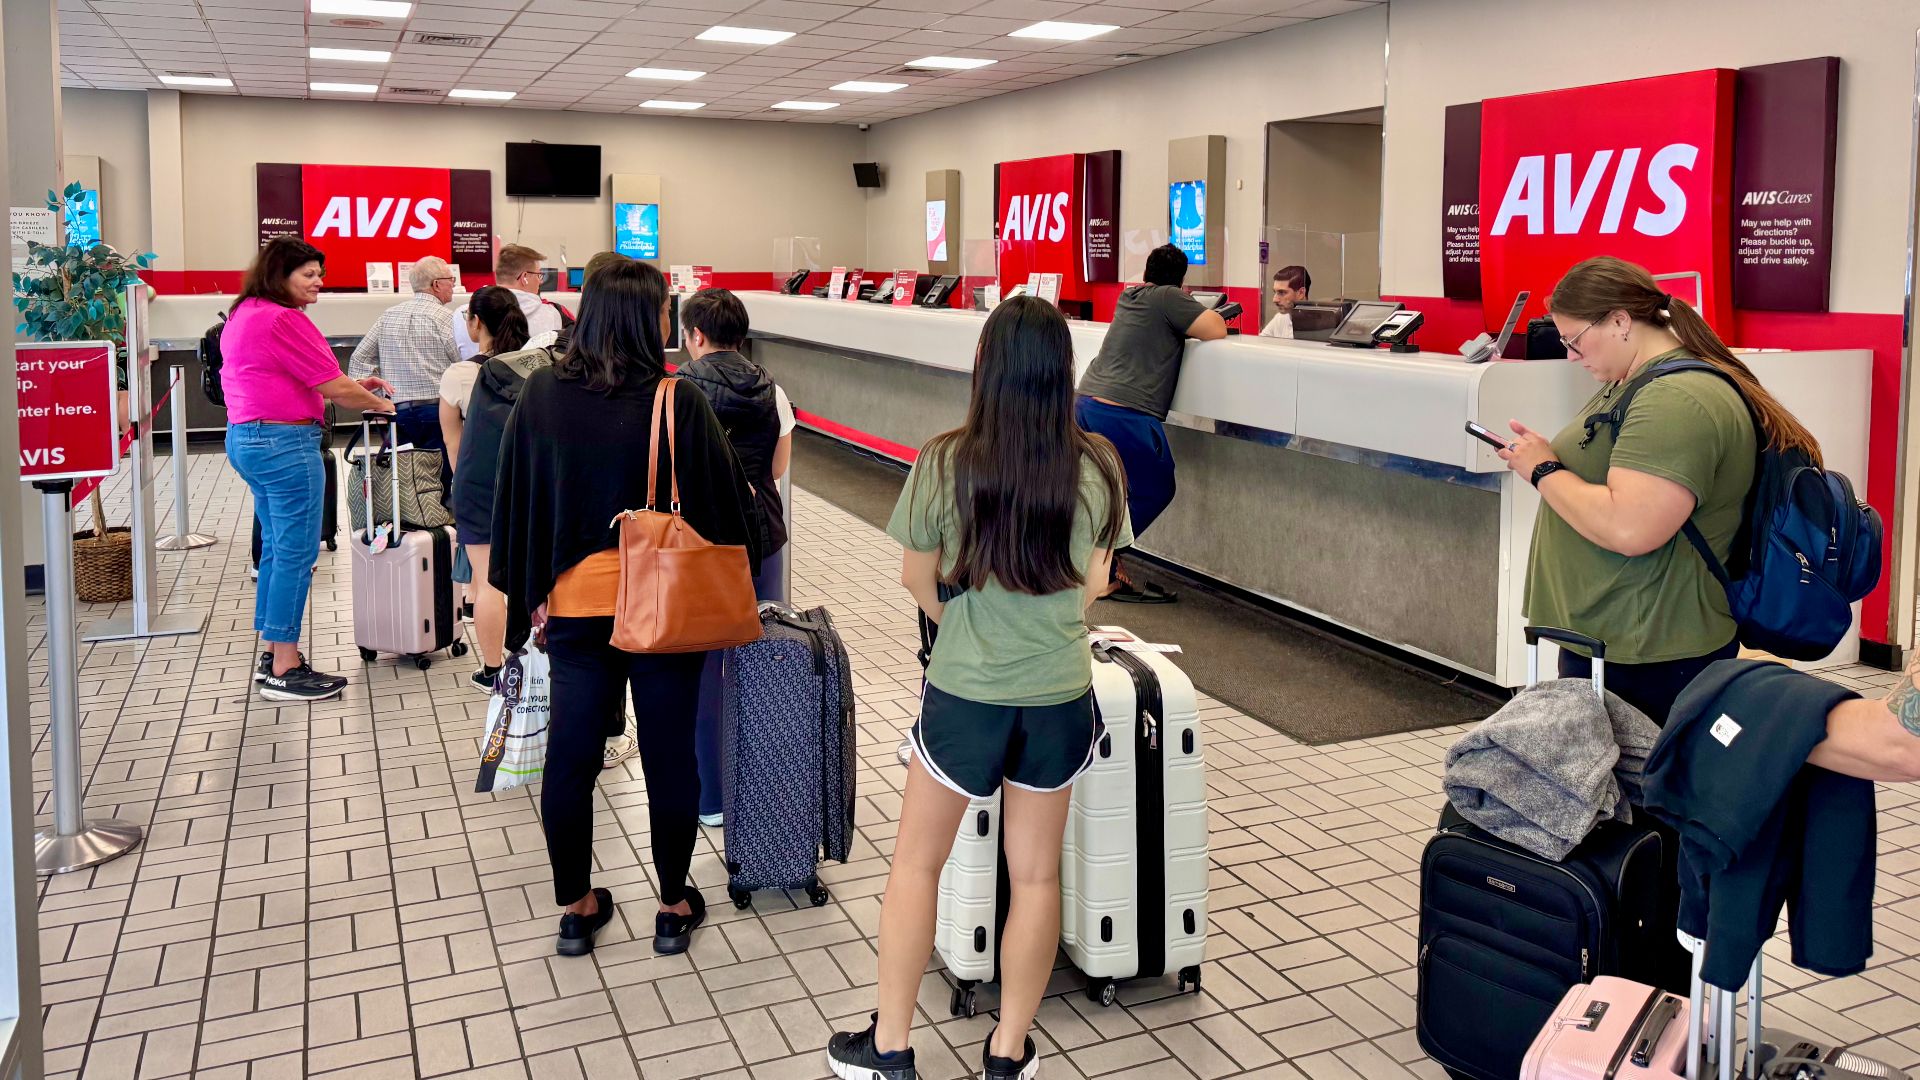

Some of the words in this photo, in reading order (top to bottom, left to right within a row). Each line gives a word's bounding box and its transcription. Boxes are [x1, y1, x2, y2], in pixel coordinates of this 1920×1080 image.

[1490, 143, 1699, 237] AVIS
[311, 196, 443, 240] AVIS
[1002, 192, 1069, 242] AVIS
[1741, 219, 1758, 228] May
[1774, 218, 1792, 228] help
[1794, 218, 1812, 226] with
[1447, 226, 1459, 234] May
[1753, 228, 1798, 236] directions?
[1740, 238, 1767, 246] Please
[1770, 237, 1797, 246] buckle
[1799, 238, 1813, 247] up,
[1738, 247, 1762, 256] adjust
[1764, 248, 1783, 256] your
[1785, 247, 1815, 255] mirrors
[1448, 255, 1460, 263] and
[1459, 255, 1474, 263] drive
[1743, 256, 1759, 265] and
[1760, 256, 1781, 265] drive
[1783, 256, 1809, 266] safely.
[48, 360, 87, 375] your
[17, 405, 51, 418] nter
[55, 402, 97, 416] here.
[265, 675, 287, 688] HOKA
[483, 727, 507, 763] tech
